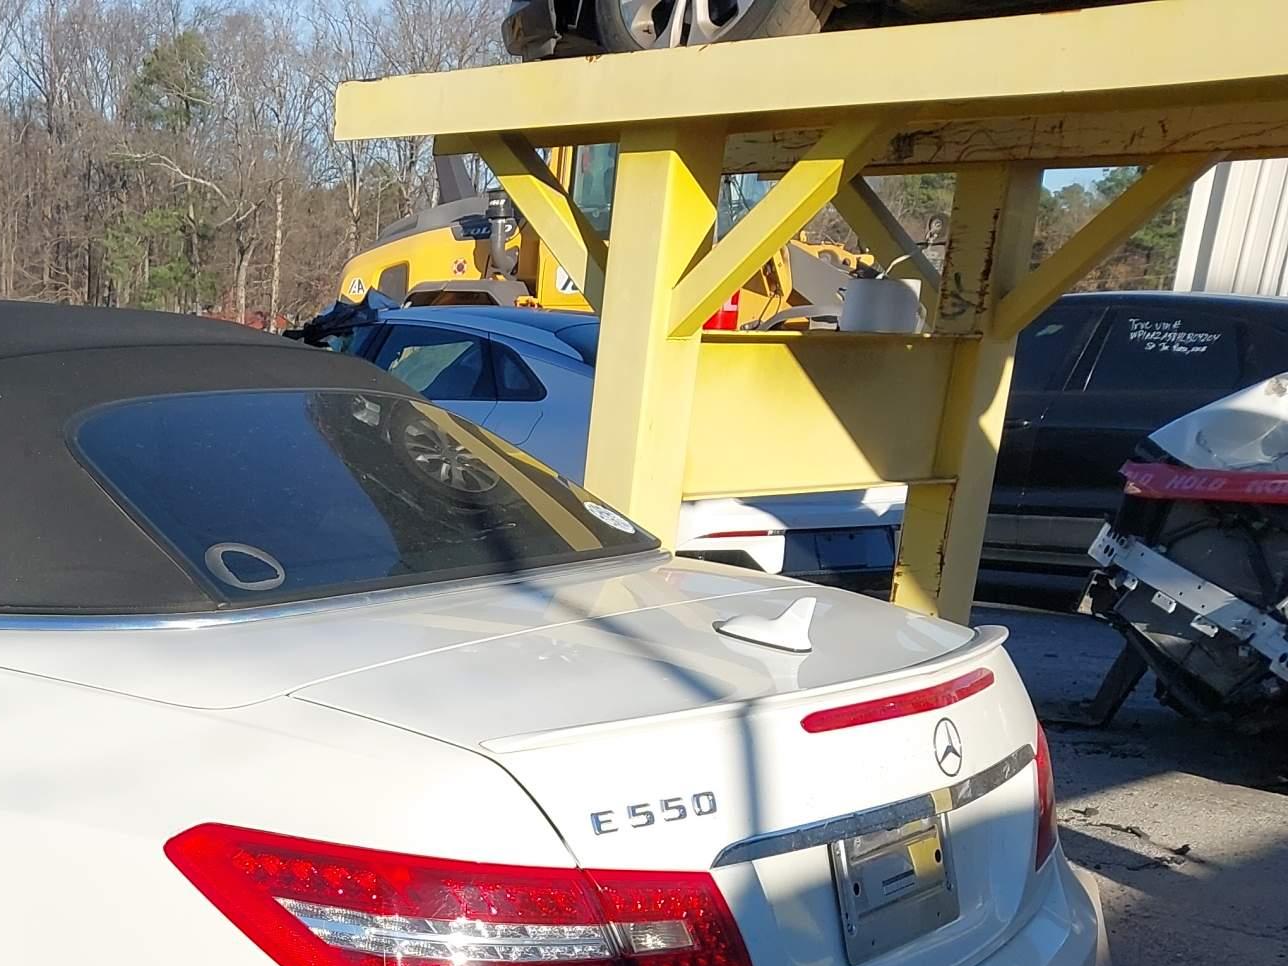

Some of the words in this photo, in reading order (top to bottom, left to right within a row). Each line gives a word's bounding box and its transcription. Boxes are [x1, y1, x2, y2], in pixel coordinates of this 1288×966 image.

[1166, 475, 1226, 491] HOLD
[590, 810, 619, 836] E
[626, 791, 718, 829] 550
